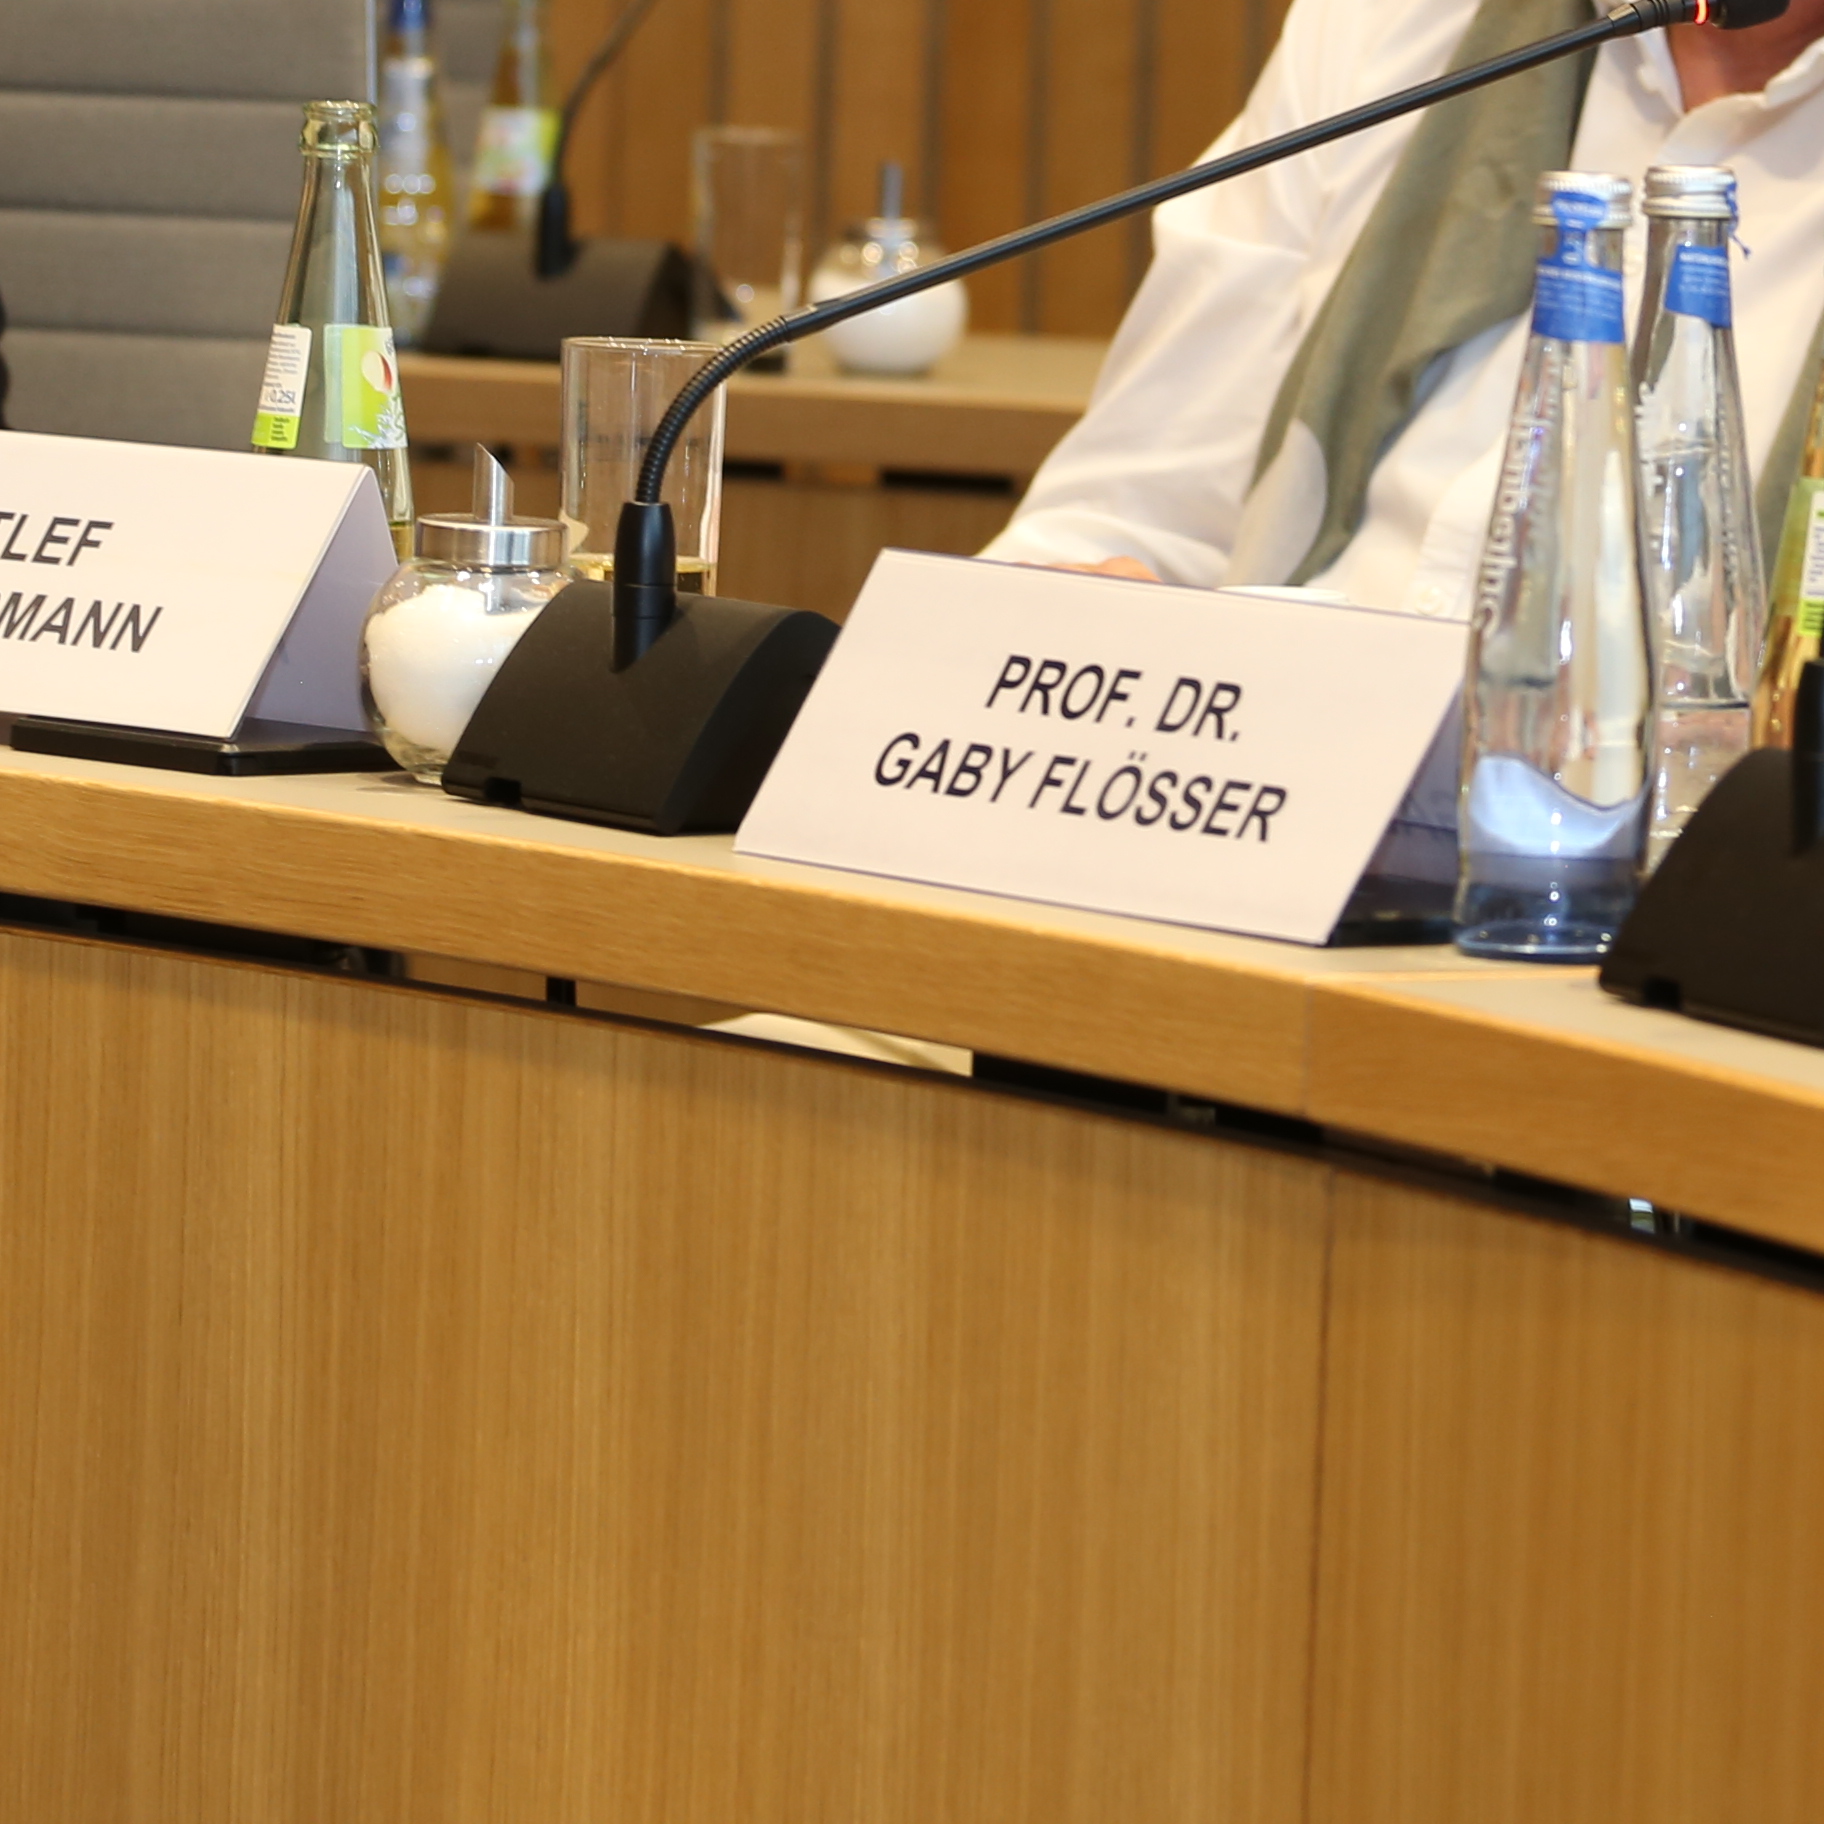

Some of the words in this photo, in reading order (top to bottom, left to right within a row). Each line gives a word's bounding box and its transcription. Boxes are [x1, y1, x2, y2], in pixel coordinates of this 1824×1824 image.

[985, 655, 1143, 728] PROF.
[1154, 677, 1243, 742] DR.
[874, 732, 1034, 804] GABY
[1027, 750, 1288, 843] FLÖSSER
